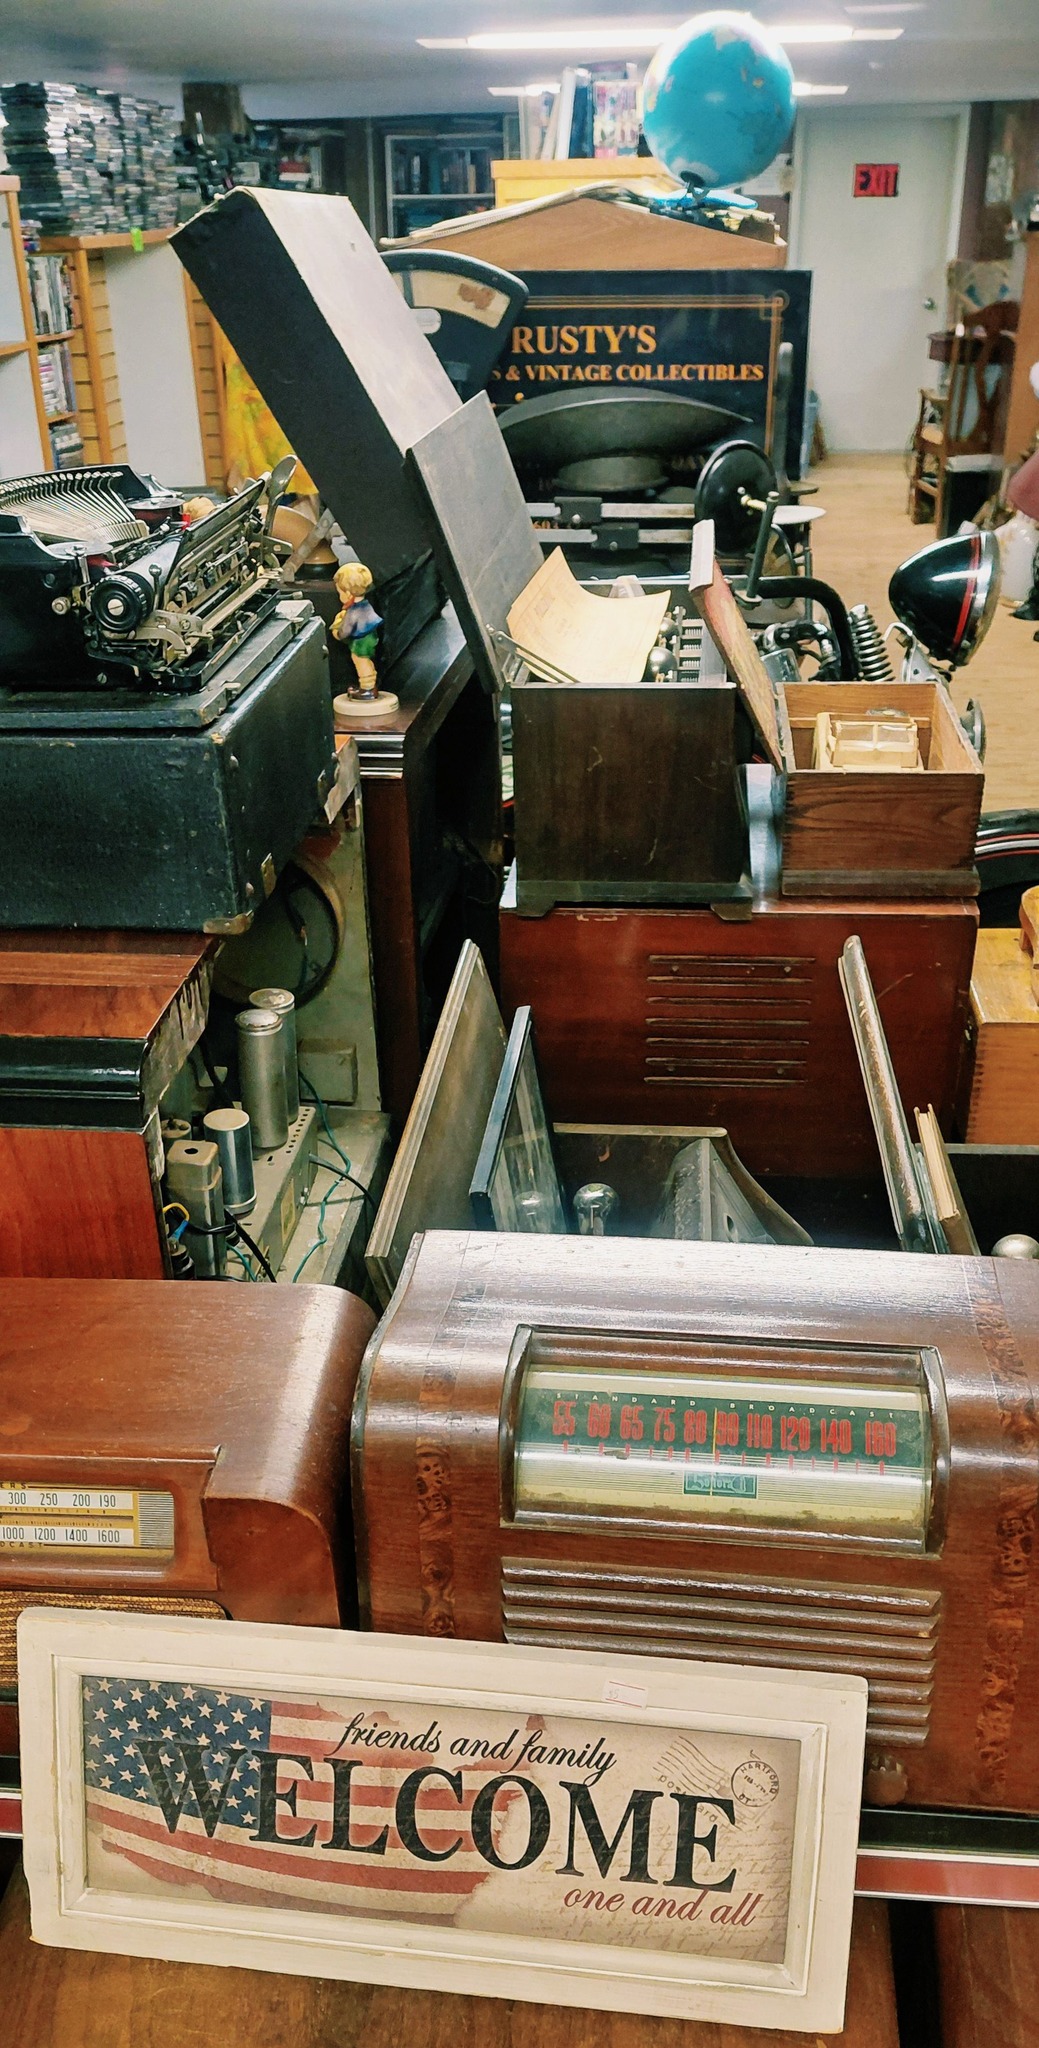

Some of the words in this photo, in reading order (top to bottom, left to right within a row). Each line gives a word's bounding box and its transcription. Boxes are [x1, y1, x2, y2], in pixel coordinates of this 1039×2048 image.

[511, 325, 657, 354] RUSTY'S
[505, 365, 521, 381] &
[524, 364, 612, 381] VINTAGE
[616, 364, 764, 382] COLLECTIBLES
[556, 1392, 696, 1406] STANDARD
[730, 1402, 894, 1418] BROADCAST
[552, 1400, 577, 1436] 55
[587, 1402, 612, 1438] 60
[620, 1404, 644, 1440] 65
[653, 1407, 676, 1442] 75
[683, 1409, 708, 1444] 80
[716, 1411, 739, 1446] 90
[746, 1413, 773, 1449] 110
[780, 1415, 811, 1451] 120
[820, 1417, 852, 1454] 140
[865, 1420, 897, 1457] 160
[8, 1492, 26, 1505] 300
[40, 1493, 58, 1506] 250
[73, 1493, 91, 1507] 200
[99, 1494, 116, 1507] 190
[2, 1527, 25, 1540] 1000
[34, 1527, 56, 1541] 1200
[65, 1529, 88, 1542] 1400
[97, 1529, 120, 1543] 1600
[324, 1712, 442, 1756] friends
[450, 1728, 516, 1761] and
[500, 1729, 618, 1787] family
[131, 1739, 737, 1893] WELCOME
[564, 1887, 625, 1912] one
[631, 1888, 709, 1922] and
[710, 1892, 764, 1927] all
